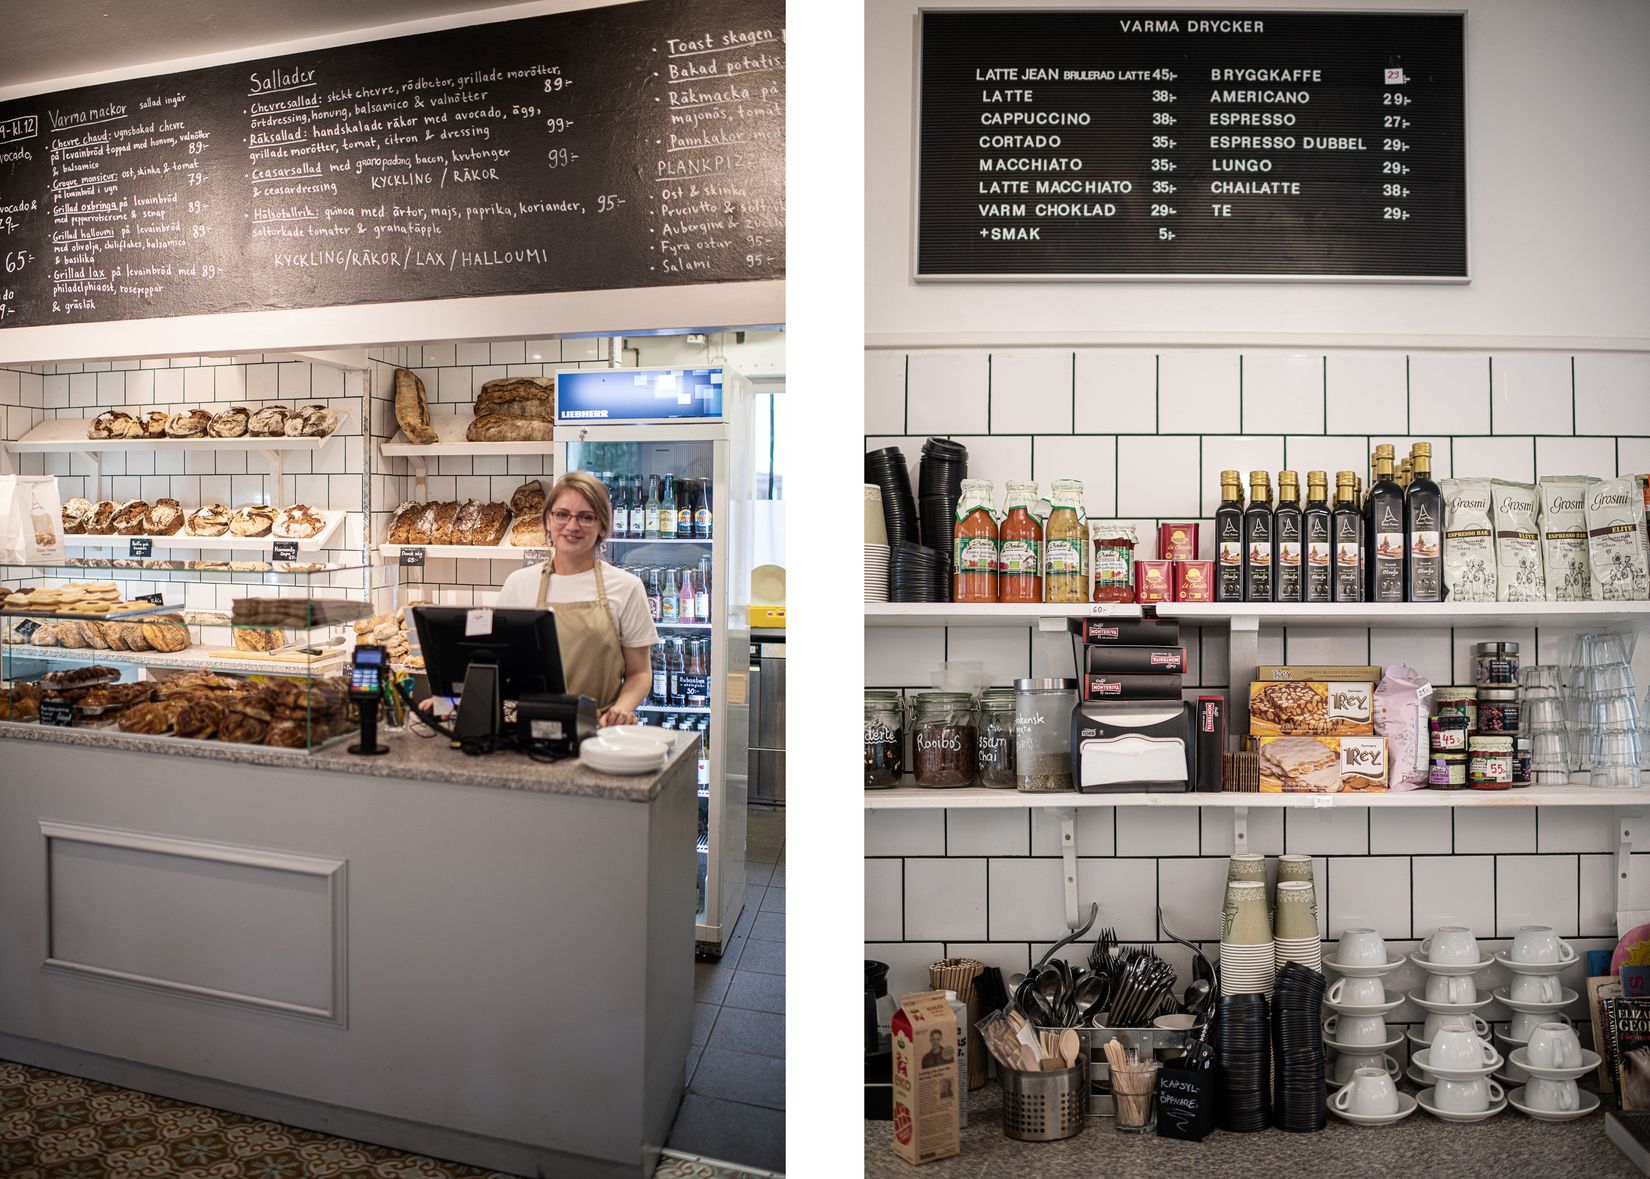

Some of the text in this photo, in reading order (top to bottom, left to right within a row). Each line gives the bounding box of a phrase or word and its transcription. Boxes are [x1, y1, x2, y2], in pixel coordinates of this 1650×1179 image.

[1120, 21, 1263, 32] VARMA DRYCKER
[668, 30, 773, 54] Toast skagen
[669, 55, 781, 78] Bakad potatis
[976, 68, 1018, 80] LATTE
[1021, 68, 1058, 80] JEAN
[1064, 71, 1114, 80] BRULERAD
[1118, 71, 1150, 80] LATTE
[250, 66, 315, 93] Sallader
[328, 65, 560, 102] stekt chevre, rödbetor, grillade morötter,
[1211, 69, 1322, 82] BRYGGKAFFE
[669, 80, 778, 105] Räkmacka på
[982, 91, 1032, 102] LATTE
[1210, 91, 1309, 103] AMERICANO
[49, 93, 186, 129] Varma mackor sallad ingår
[251, 92, 488, 129] örtdressing, honung, balsamico valnötter
[671, 101, 782, 128] majonäs, tomat
[313, 105, 541, 138] handskalade räkor med avocado, ägg,
[981, 113, 1090, 125] CAPPUCCINO
[1210, 114, 1296, 125] ESPRESSO
[52, 121, 184, 150] Chevre ugnsbakad chevre
[670, 129, 744, 147] Pannkakor
[979, 136, 1061, 148] CORTADO
[1211, 137, 1296, 148] ESPRESSO
[1303, 138, 1366, 150] DUBBEL
[63, 130, 210, 160] levainbröd toppad med valnötter
[250, 126, 489, 164] grillade morötter, tomat, citron dressing
[63, 162, 99, 173] balsamico
[137, 159, 199, 176] skinka tomat
[252, 163, 322, 180] Ceasarsallad
[330, 160, 350, 171] med
[415, 153, 448, 166] bacon,
[452, 148, 510, 163] krutonger
[980, 159, 1082, 171] MACCHIATO
[1212, 159, 1272, 171] LUNGO
[372, 168, 499, 189] KYCKLING RÄKOR
[104, 186, 118, 197] ugn
[265, 182, 337, 196] ceasardressing
[662, 184, 745, 199] Ost skinka
[979, 182, 1028, 193] LATTE
[1036, 182, 1132, 193] MACCHIATO
[1211, 182, 1300, 194] CHAILATTE
[53, 194, 177, 214] Grillad oxbringa levainbröd
[325, 200, 585, 220] quinoa med ärtor, majs, paprika, koriander,
[979, 205, 1026, 216] VARM
[1036, 204, 1115, 216] CHOKLAD
[1212, 205, 1232, 216] TE
[54, 210, 166, 225] med senap
[52, 223, 180, 241] Grillad halloumi levainbröd
[252, 222, 442, 239] soltorkade tomater granatäpple
[663, 221, 724, 238] Aubergine
[980, 228, 1040, 240] +SMAK
[72, 238, 186, 254] olivolja, balsamico
[662, 239, 732, 255] Fyra ostar
[64, 254, 94, 264] basilika
[663, 256, 711, 273] Salami
[54, 263, 195, 279] Grillad lax levainbröd med
[65, 300, 95, 313] gräslök
[562, 410, 608, 418] LIEBHERR
[1451, 498, 1486, 514] Grosmi
[1500, 497, 1534, 514] Grosmi
[1550, 497, 1584, 513] Grosm
[1591, 493, 1628, 511] Grosmi
[1612, 525, 1634, 533] ELITE
[917, 735, 961, 751] Rooibos
